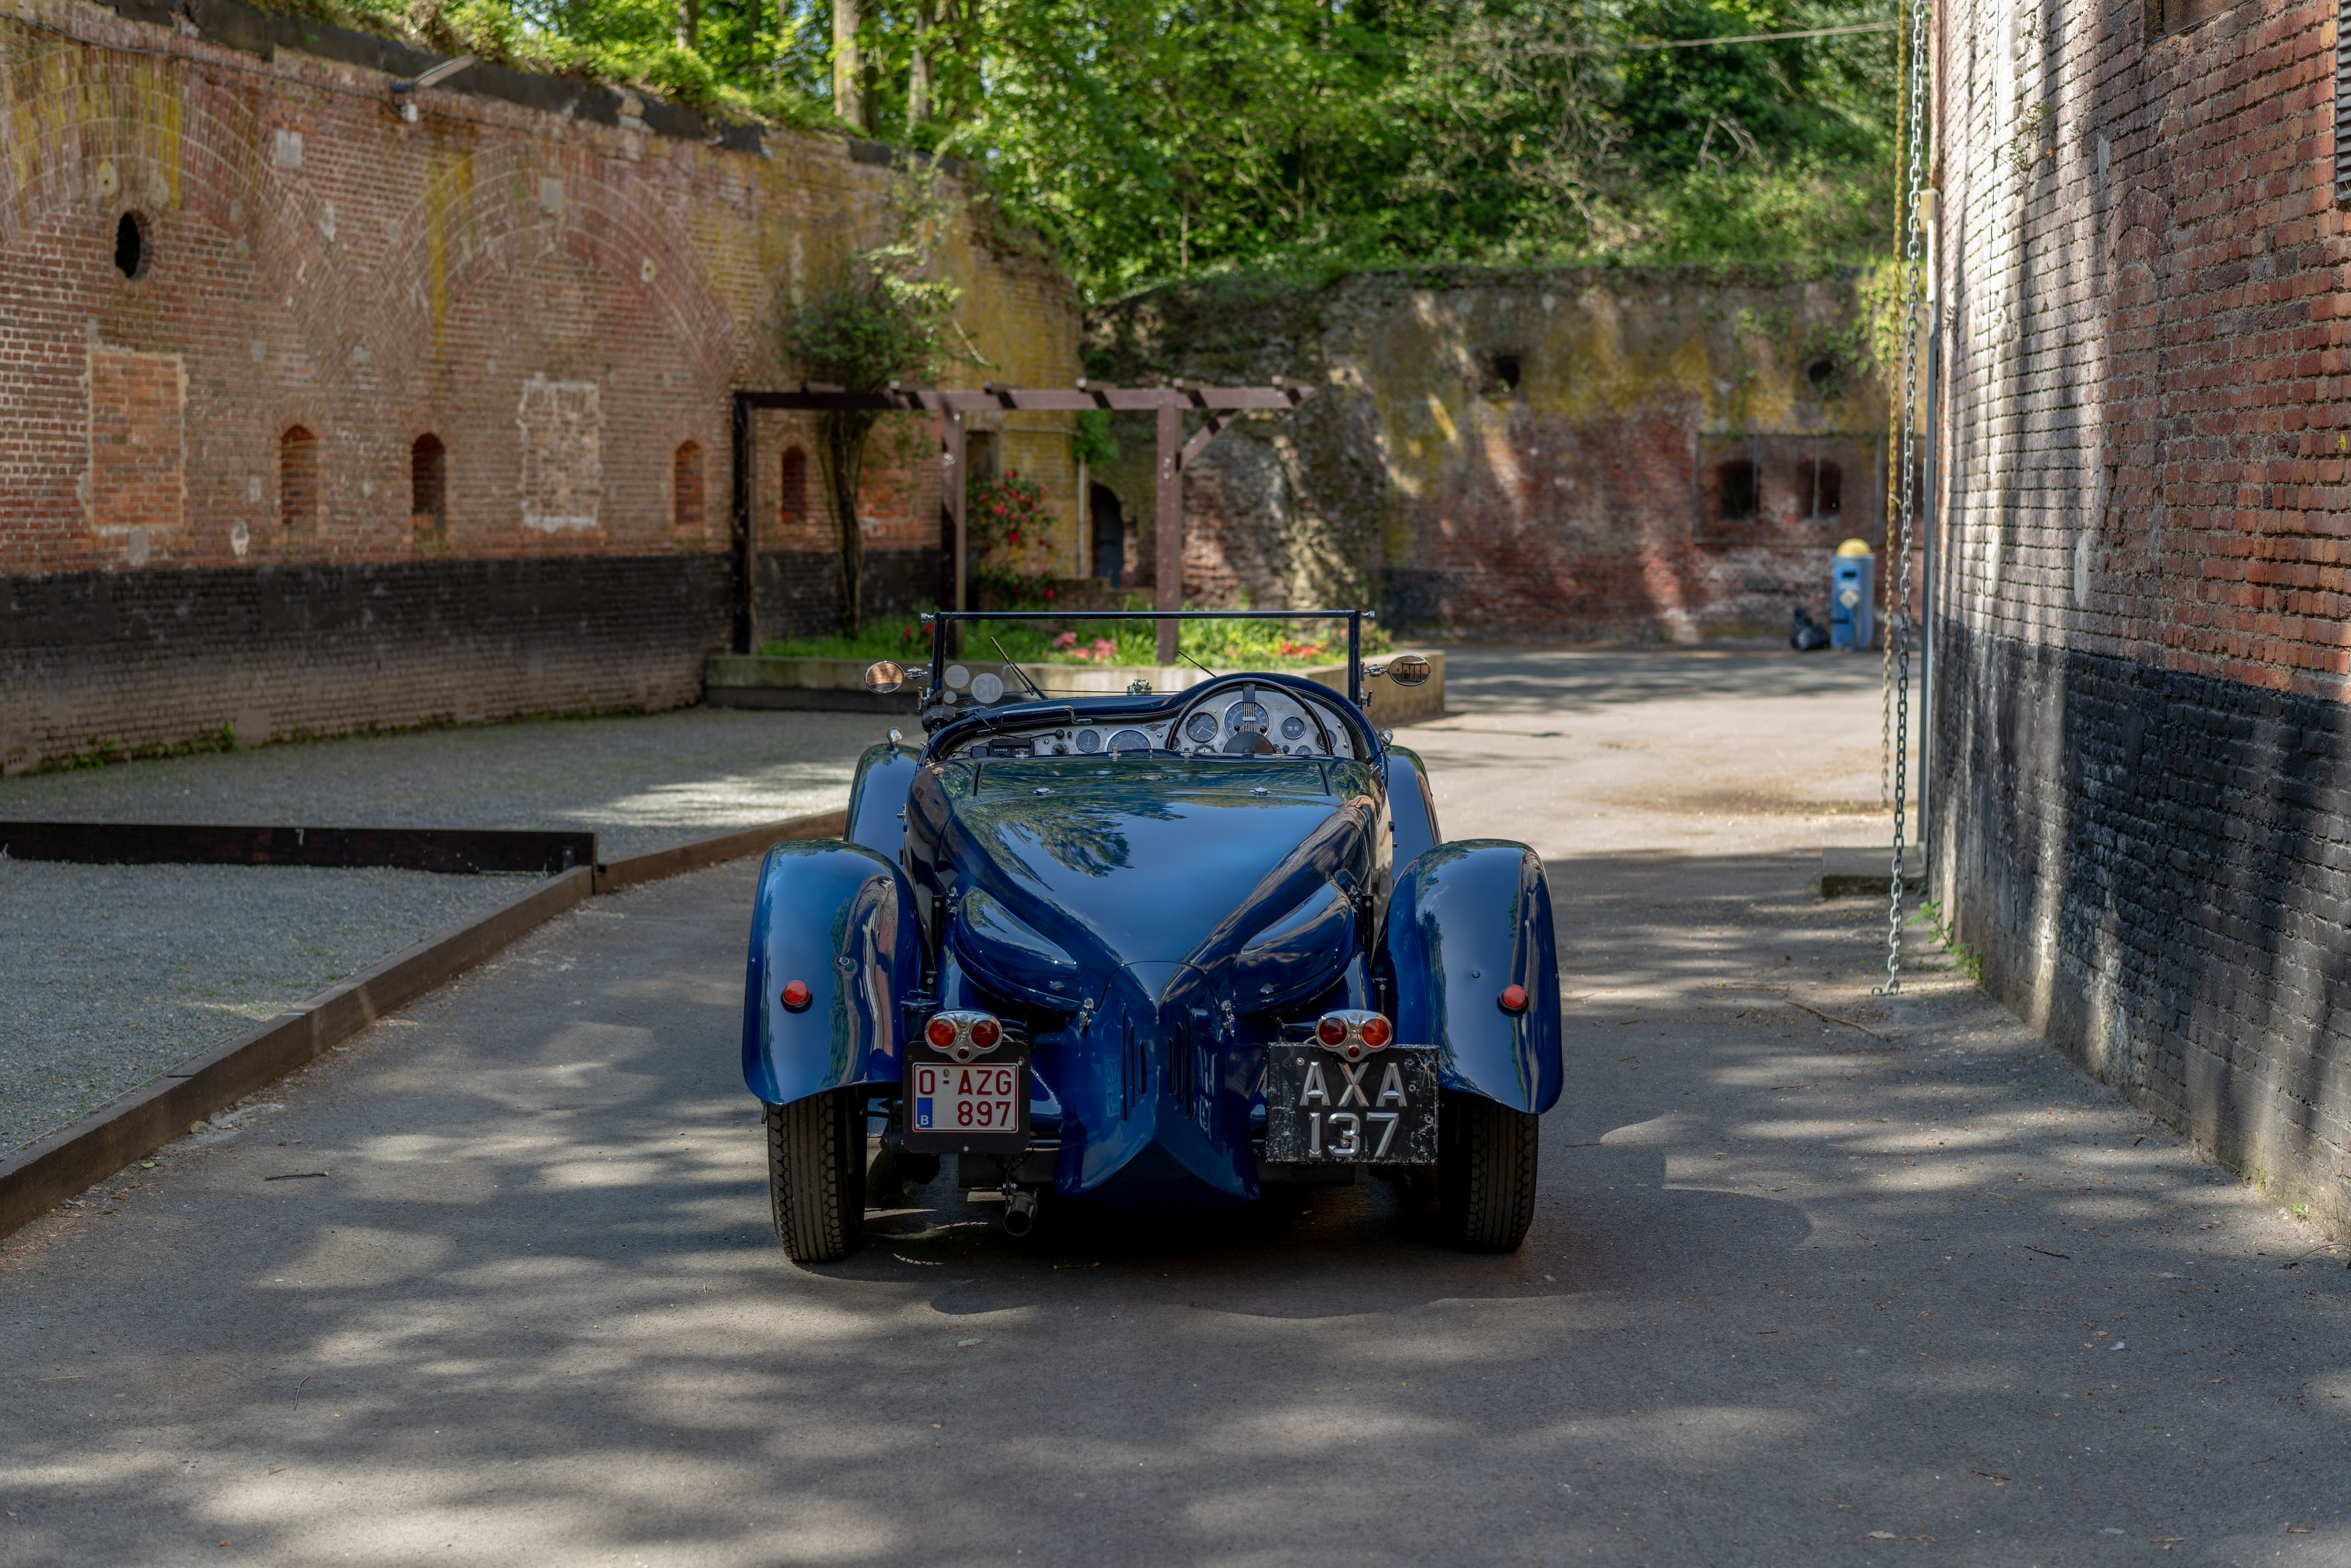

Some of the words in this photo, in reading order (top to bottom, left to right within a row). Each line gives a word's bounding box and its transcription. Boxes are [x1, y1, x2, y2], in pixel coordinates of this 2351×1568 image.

[1299, 1061, 1408, 1107] AXA
[920, 1115, 929, 1125] B
[957, 1100, 1011, 1127] 897
[1308, 1112, 1399, 1158] 137
